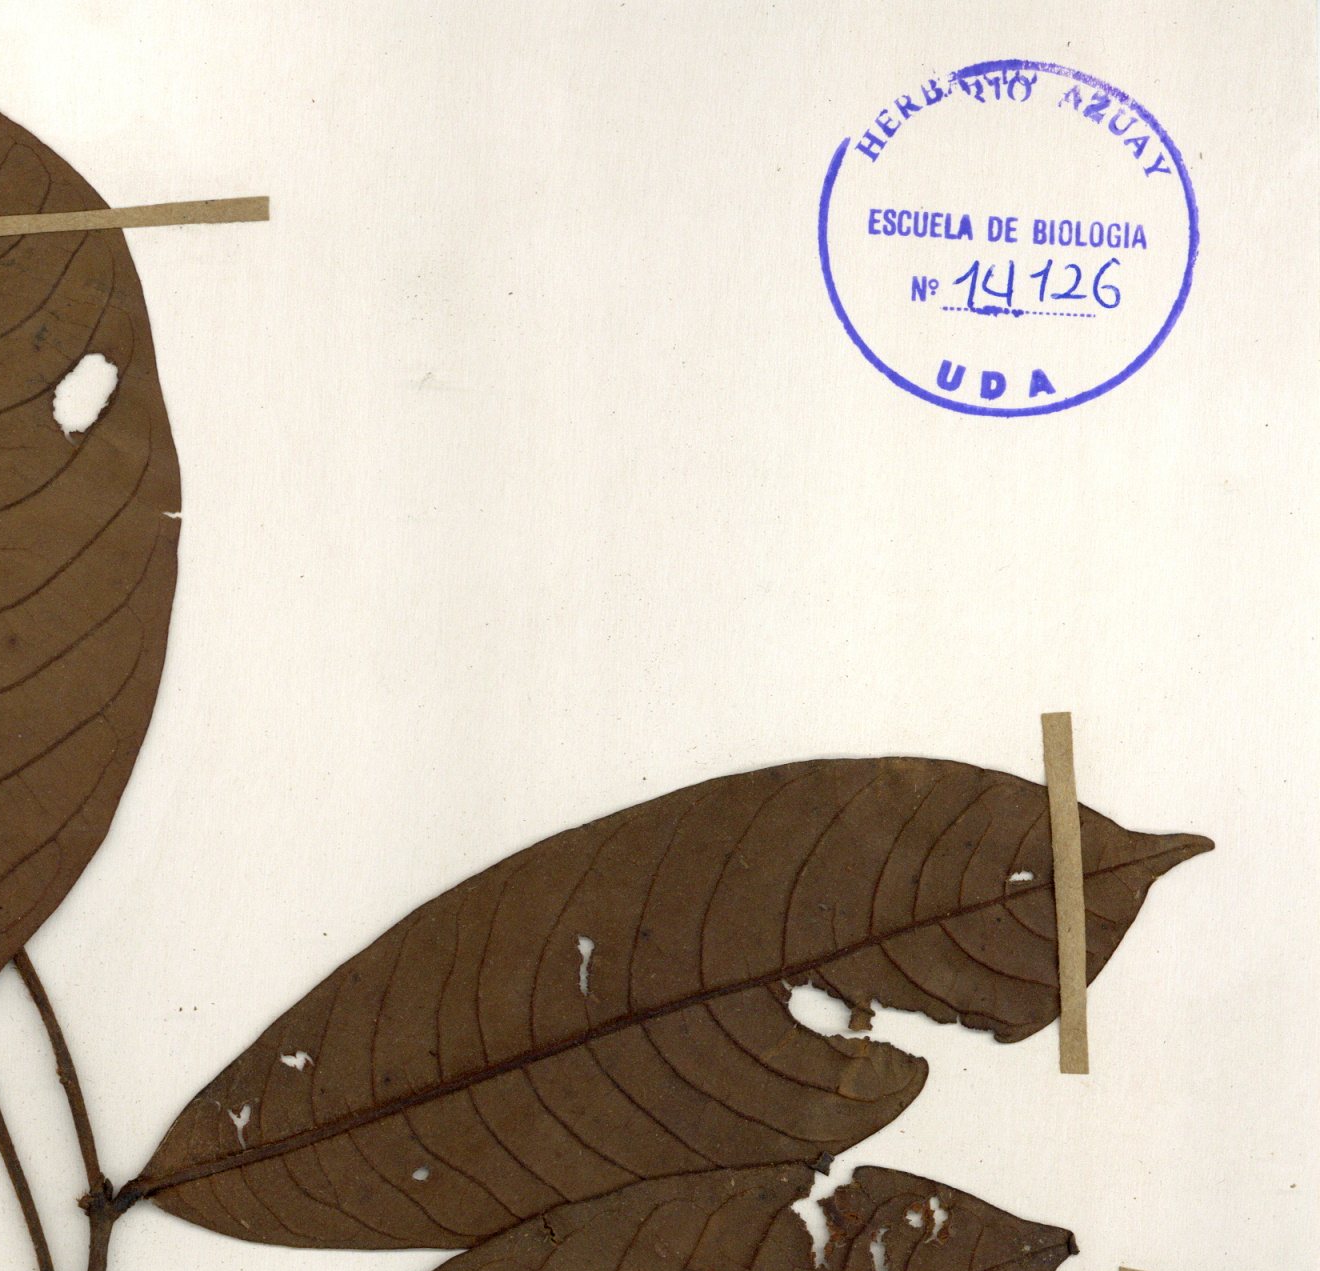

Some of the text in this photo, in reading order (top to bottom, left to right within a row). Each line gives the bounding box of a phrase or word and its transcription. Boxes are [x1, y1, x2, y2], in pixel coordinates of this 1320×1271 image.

[1058, 84, 1172, 178] AZUAY
[867, 208, 1148, 250] ESCUELA DE BIOLOGIA
[952, 257, 1122, 312] 14126
[936, 359, 1057, 401] UDA
